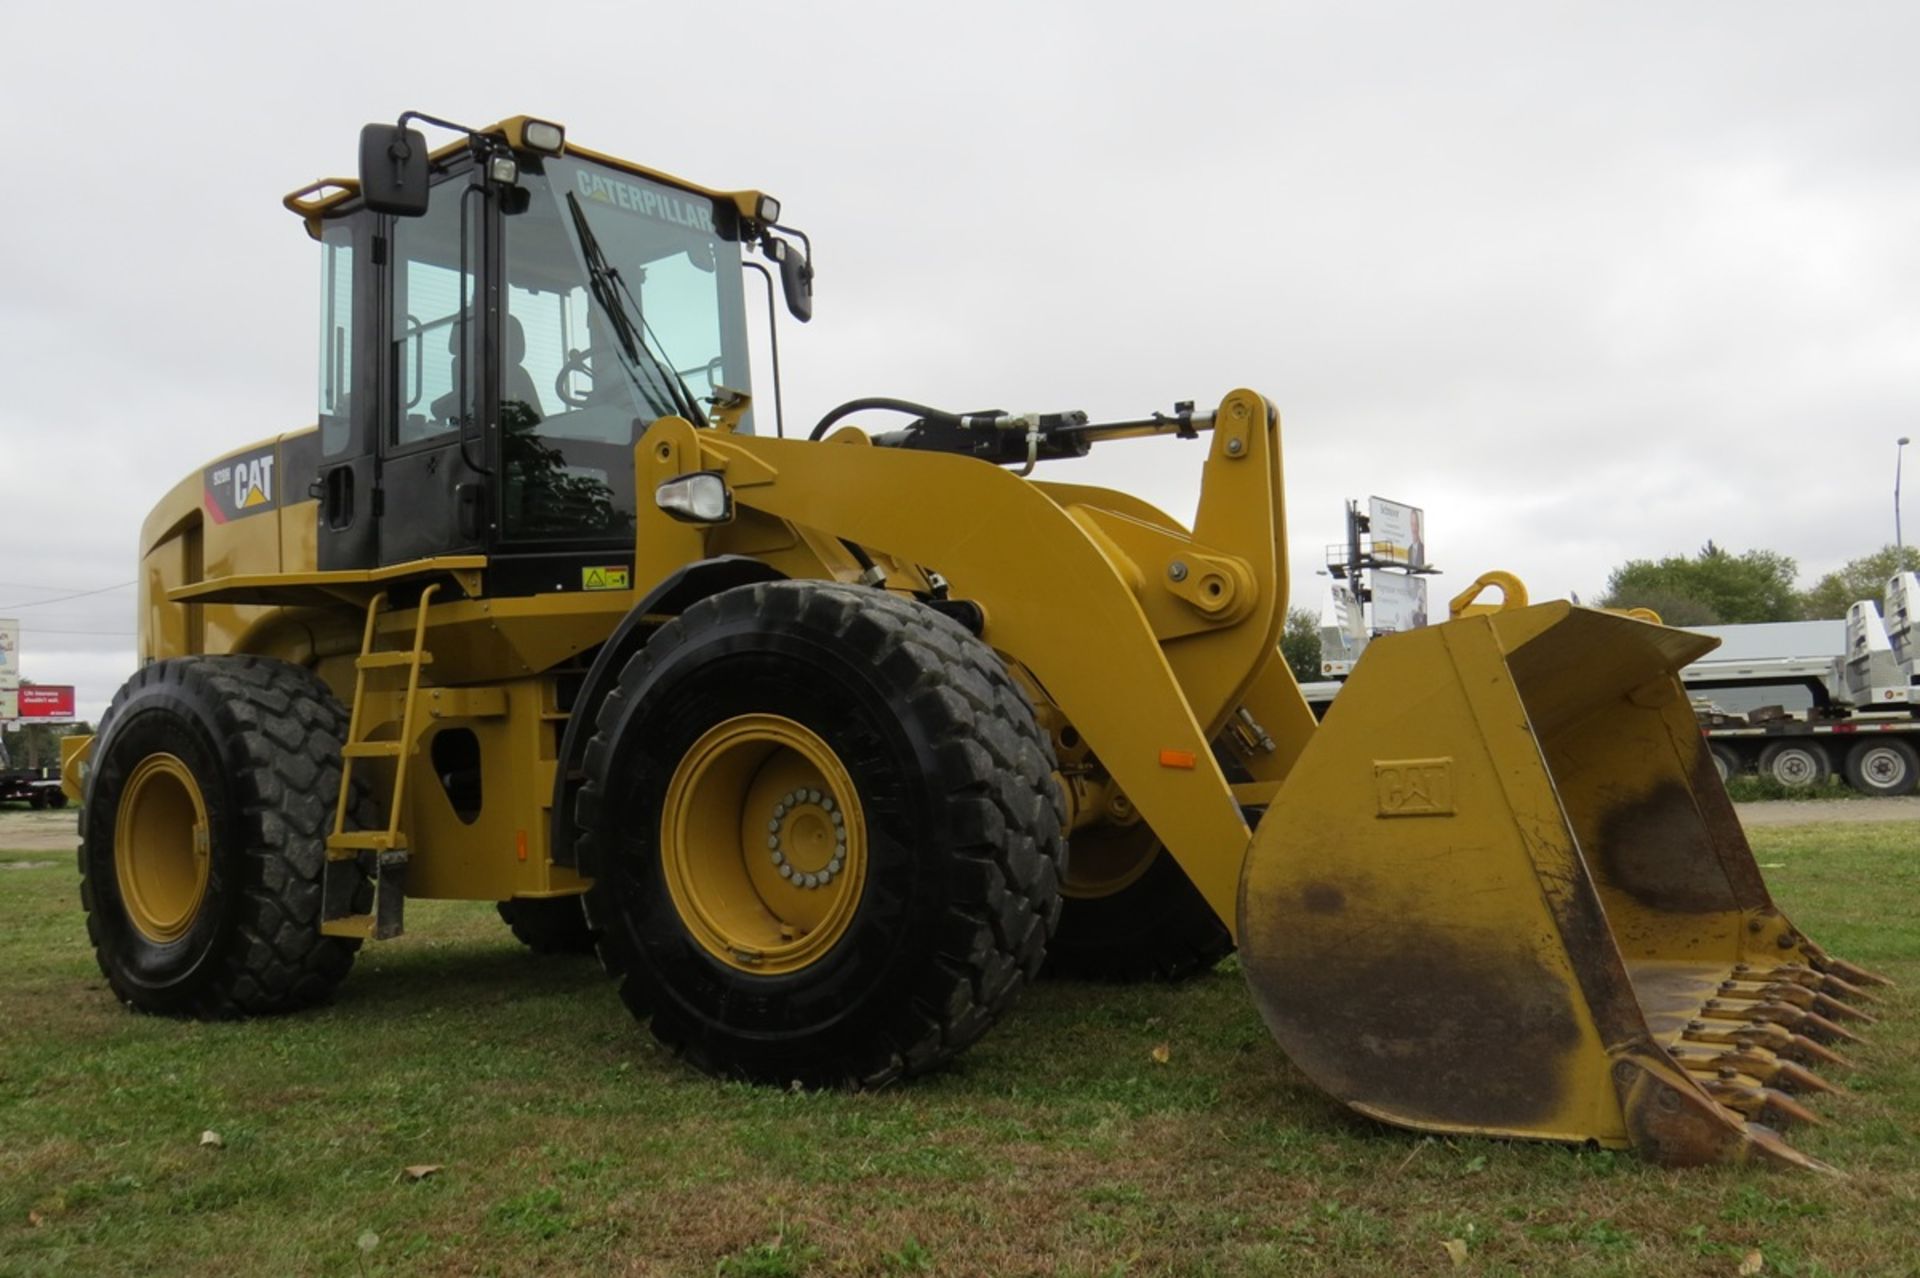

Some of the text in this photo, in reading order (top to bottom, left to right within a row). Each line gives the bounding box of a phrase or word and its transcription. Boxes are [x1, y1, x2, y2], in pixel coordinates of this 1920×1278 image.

[576, 169, 716, 233] CATERPILLAR
[234, 455, 274, 509] CAT
[1379, 766, 1446, 811] CAT
